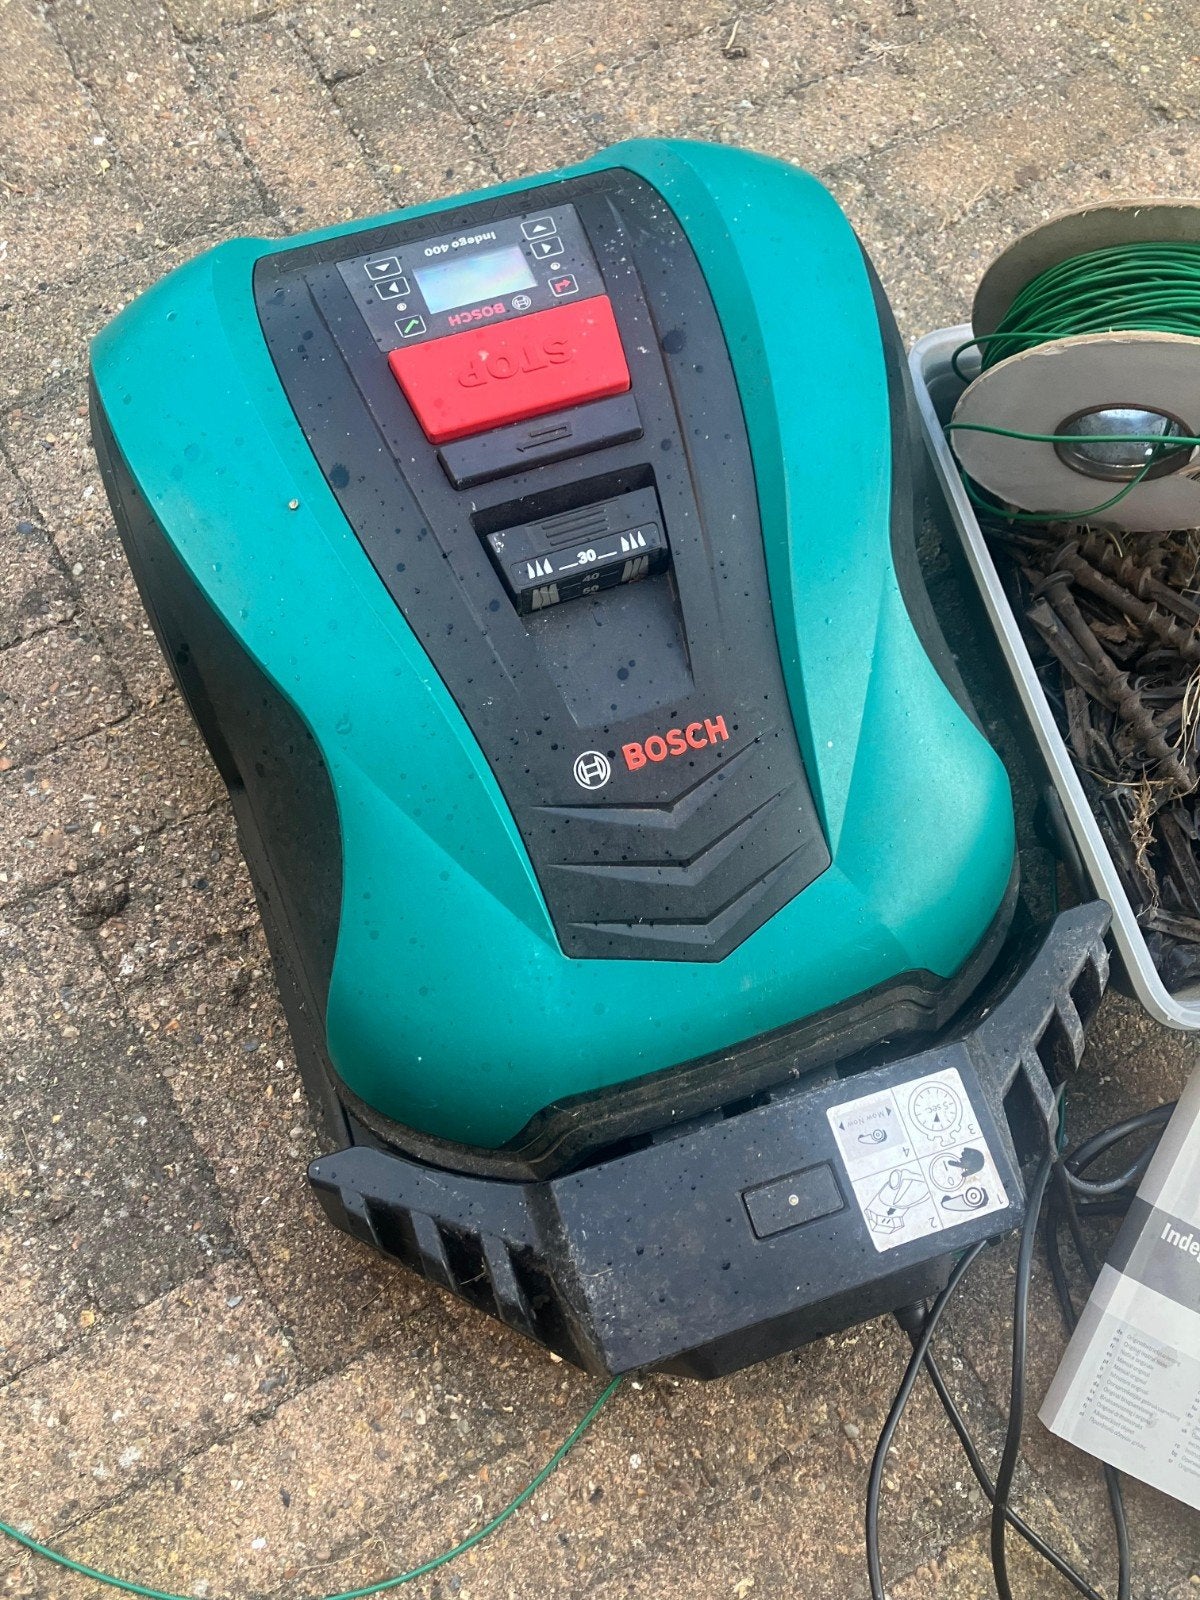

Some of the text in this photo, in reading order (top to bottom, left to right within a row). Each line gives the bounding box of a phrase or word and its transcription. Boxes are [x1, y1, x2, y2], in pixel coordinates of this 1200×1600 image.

[424, 231, 497, 257] Indego 400
[448, 302, 506, 327] BOSCH
[458, 337, 573, 388] STOP
[576, 548, 597, 565] 30
[622, 715, 729, 771] BOSCH
[848, 1111, 885, 1127] Mow Now
[967, 1123, 976, 1135] 3
[902, 1146, 910, 1157] 4
[928, 1216, 938, 1228] 2
[1160, 1222, 1200, 1263] Inde
